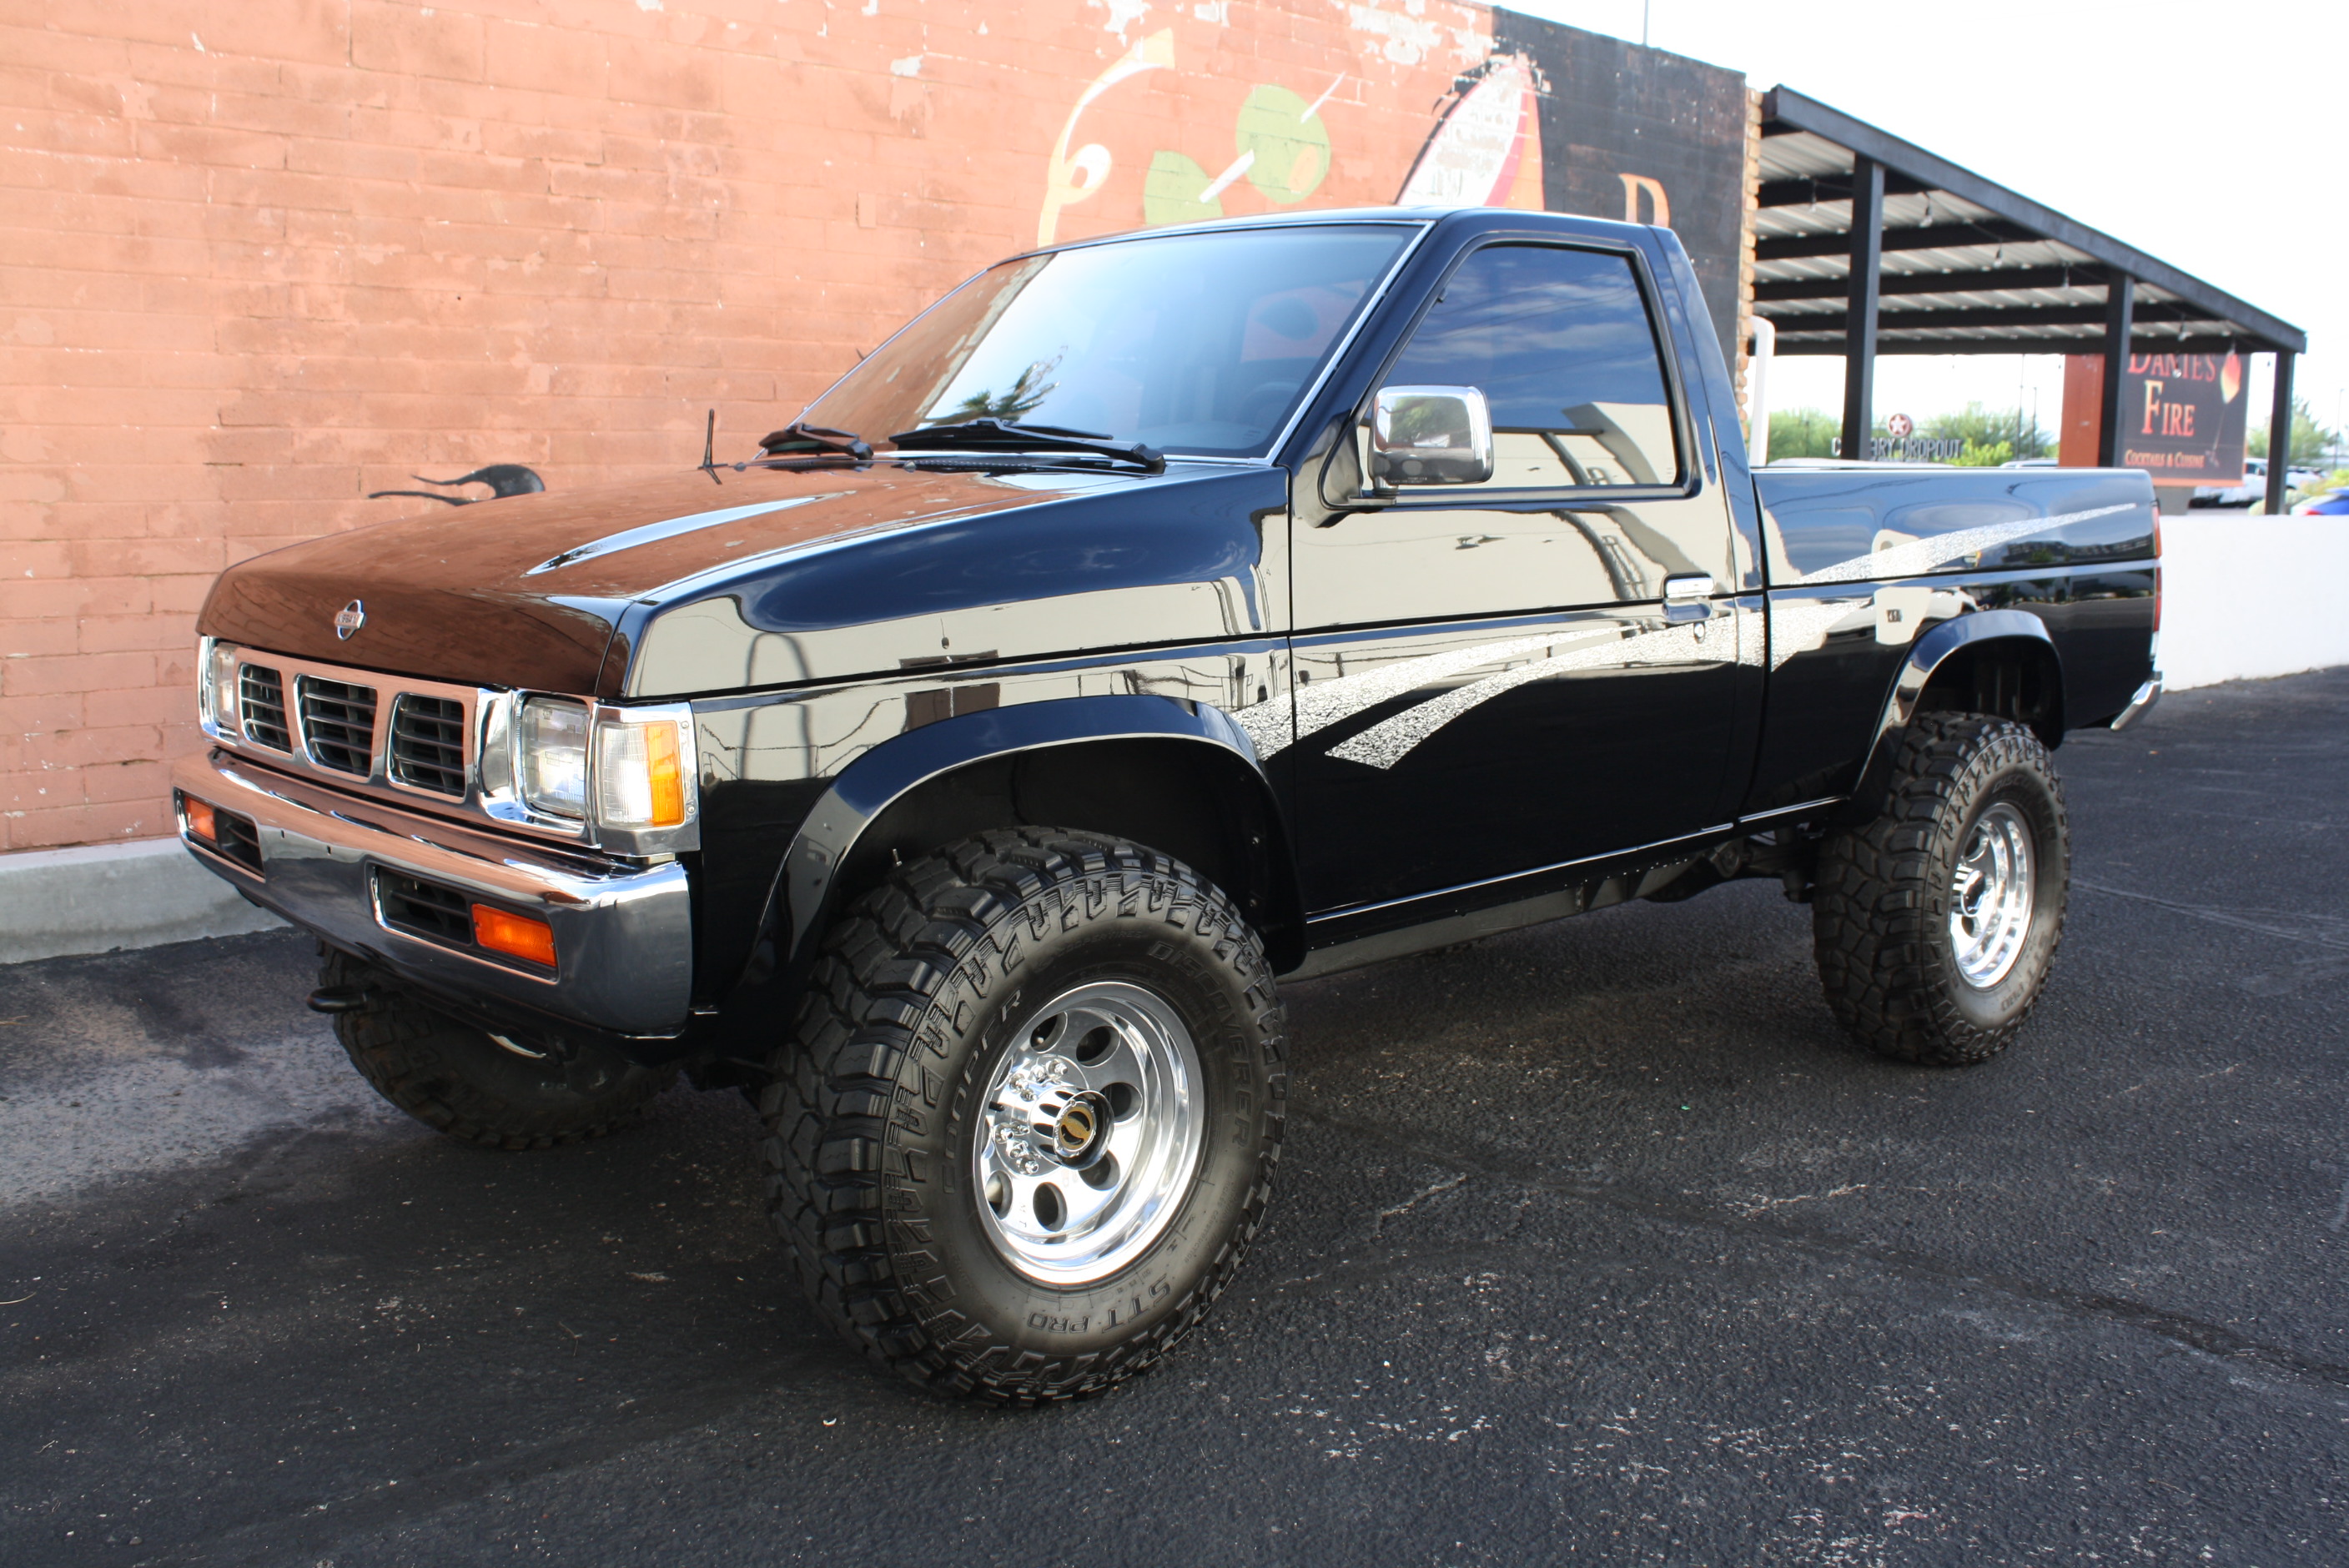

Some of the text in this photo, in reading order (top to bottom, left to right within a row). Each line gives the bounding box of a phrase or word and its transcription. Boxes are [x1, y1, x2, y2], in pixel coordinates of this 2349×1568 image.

[2141, 379, 2196, 437] FIRE
[1900, 438, 1962, 459] DROPOUT
[1148, 940, 1252, 1148] DISCOVERER
[1027, 1273, 1171, 1334] STT PRO
